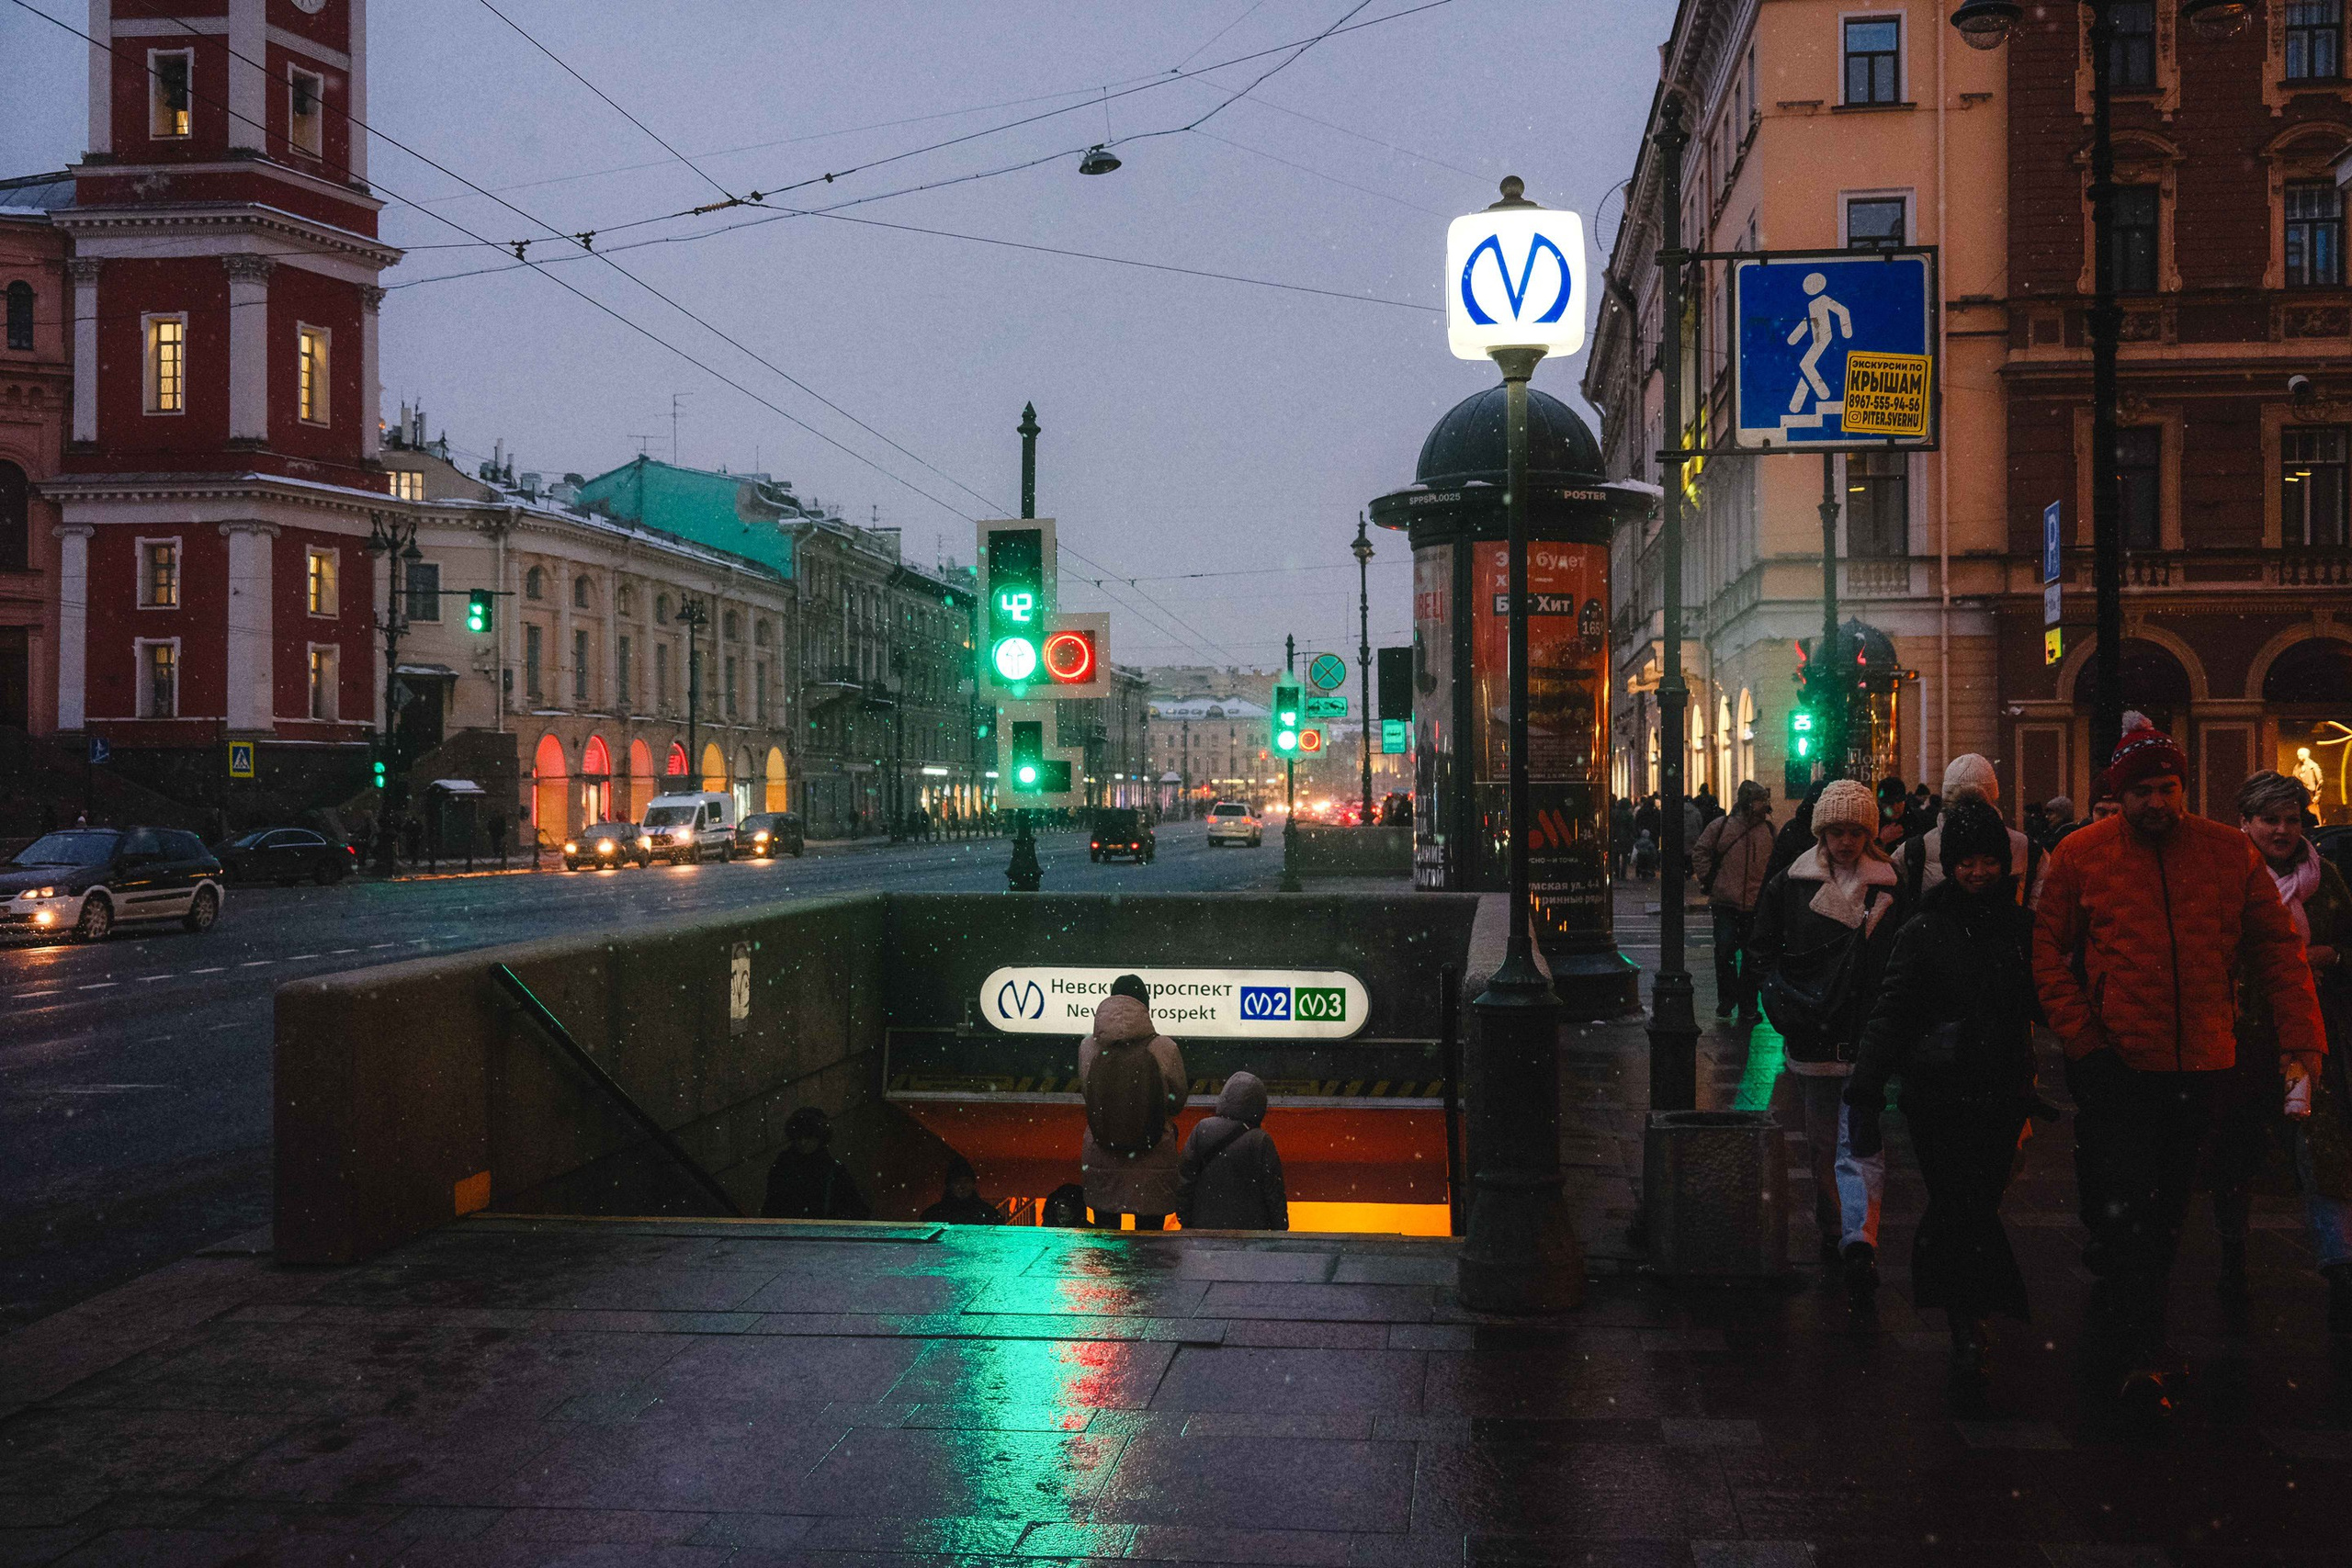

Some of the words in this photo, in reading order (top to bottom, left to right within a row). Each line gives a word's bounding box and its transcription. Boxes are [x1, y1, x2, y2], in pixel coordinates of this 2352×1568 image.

[1852, 360, 1907, 371] ЭКСКУРСИИ
[1909, 364, 1922, 372] ПО
[1850, 370, 1922, 394] КРЫШАМ
[1849, 394, 1919, 412] 8967-555-94-56
[1861, 411, 1919, 428] PITER.SVERHU
[1564, 490, 1606, 502] POSTER
[1536, 551, 1585, 570] будет
[1001, 593, 1032, 621] 42
[1536, 595, 1570, 612] Хит
[1051, 978, 1112, 994] Невск
[1151, 1005, 1216, 1022] rospekt
